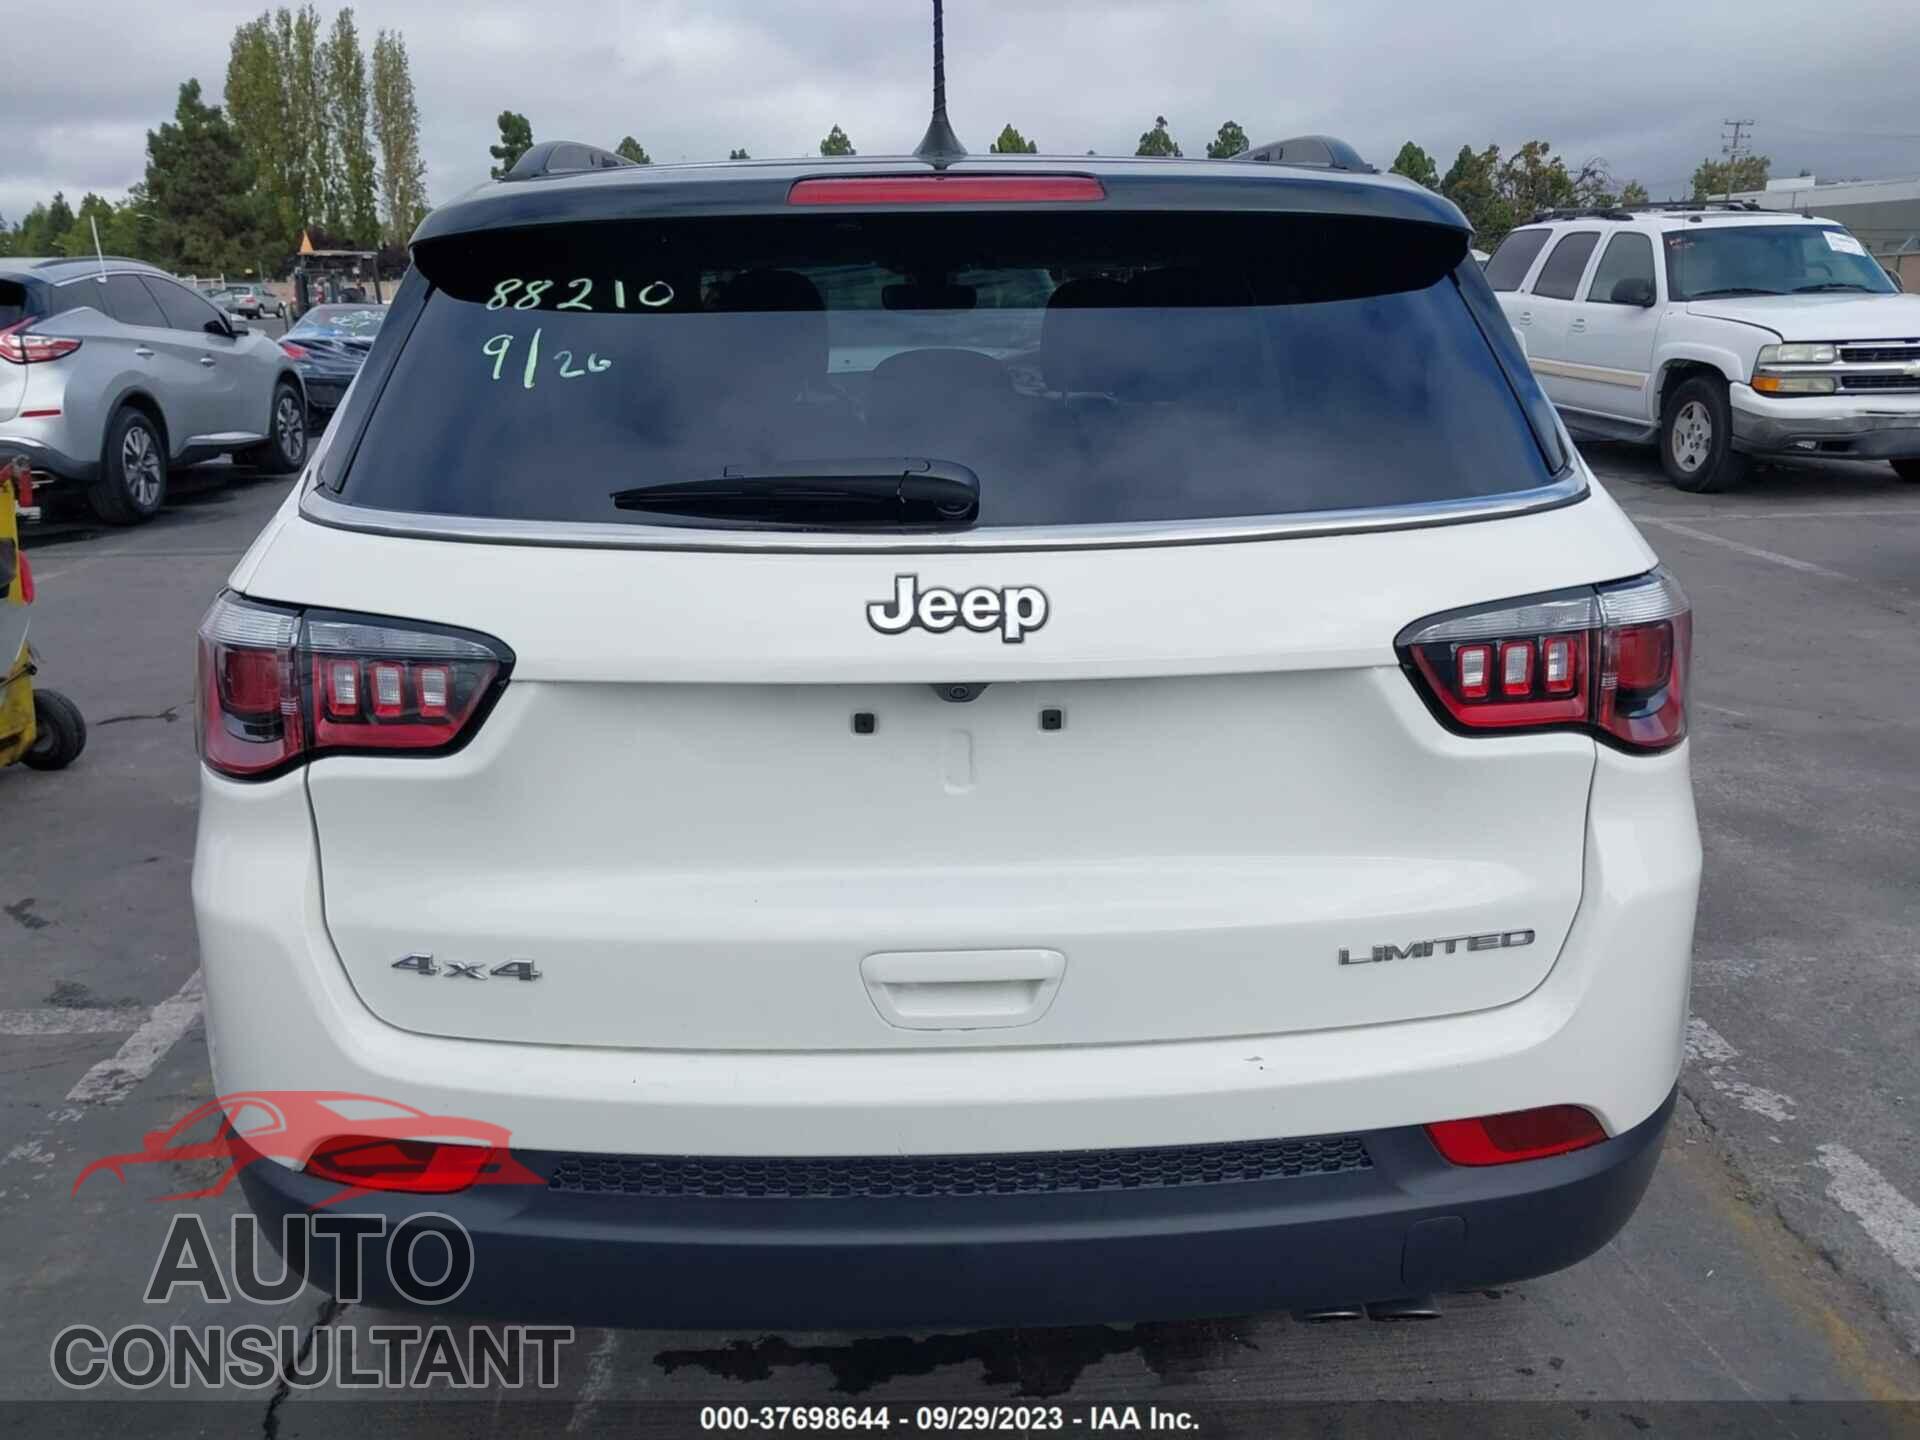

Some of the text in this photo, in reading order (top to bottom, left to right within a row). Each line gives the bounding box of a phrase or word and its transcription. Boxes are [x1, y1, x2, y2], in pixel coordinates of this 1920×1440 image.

[485, 278, 675, 310] 88210
[866, 574, 1049, 643] Jeep
[1338, 928, 1535, 966] LIMITED
